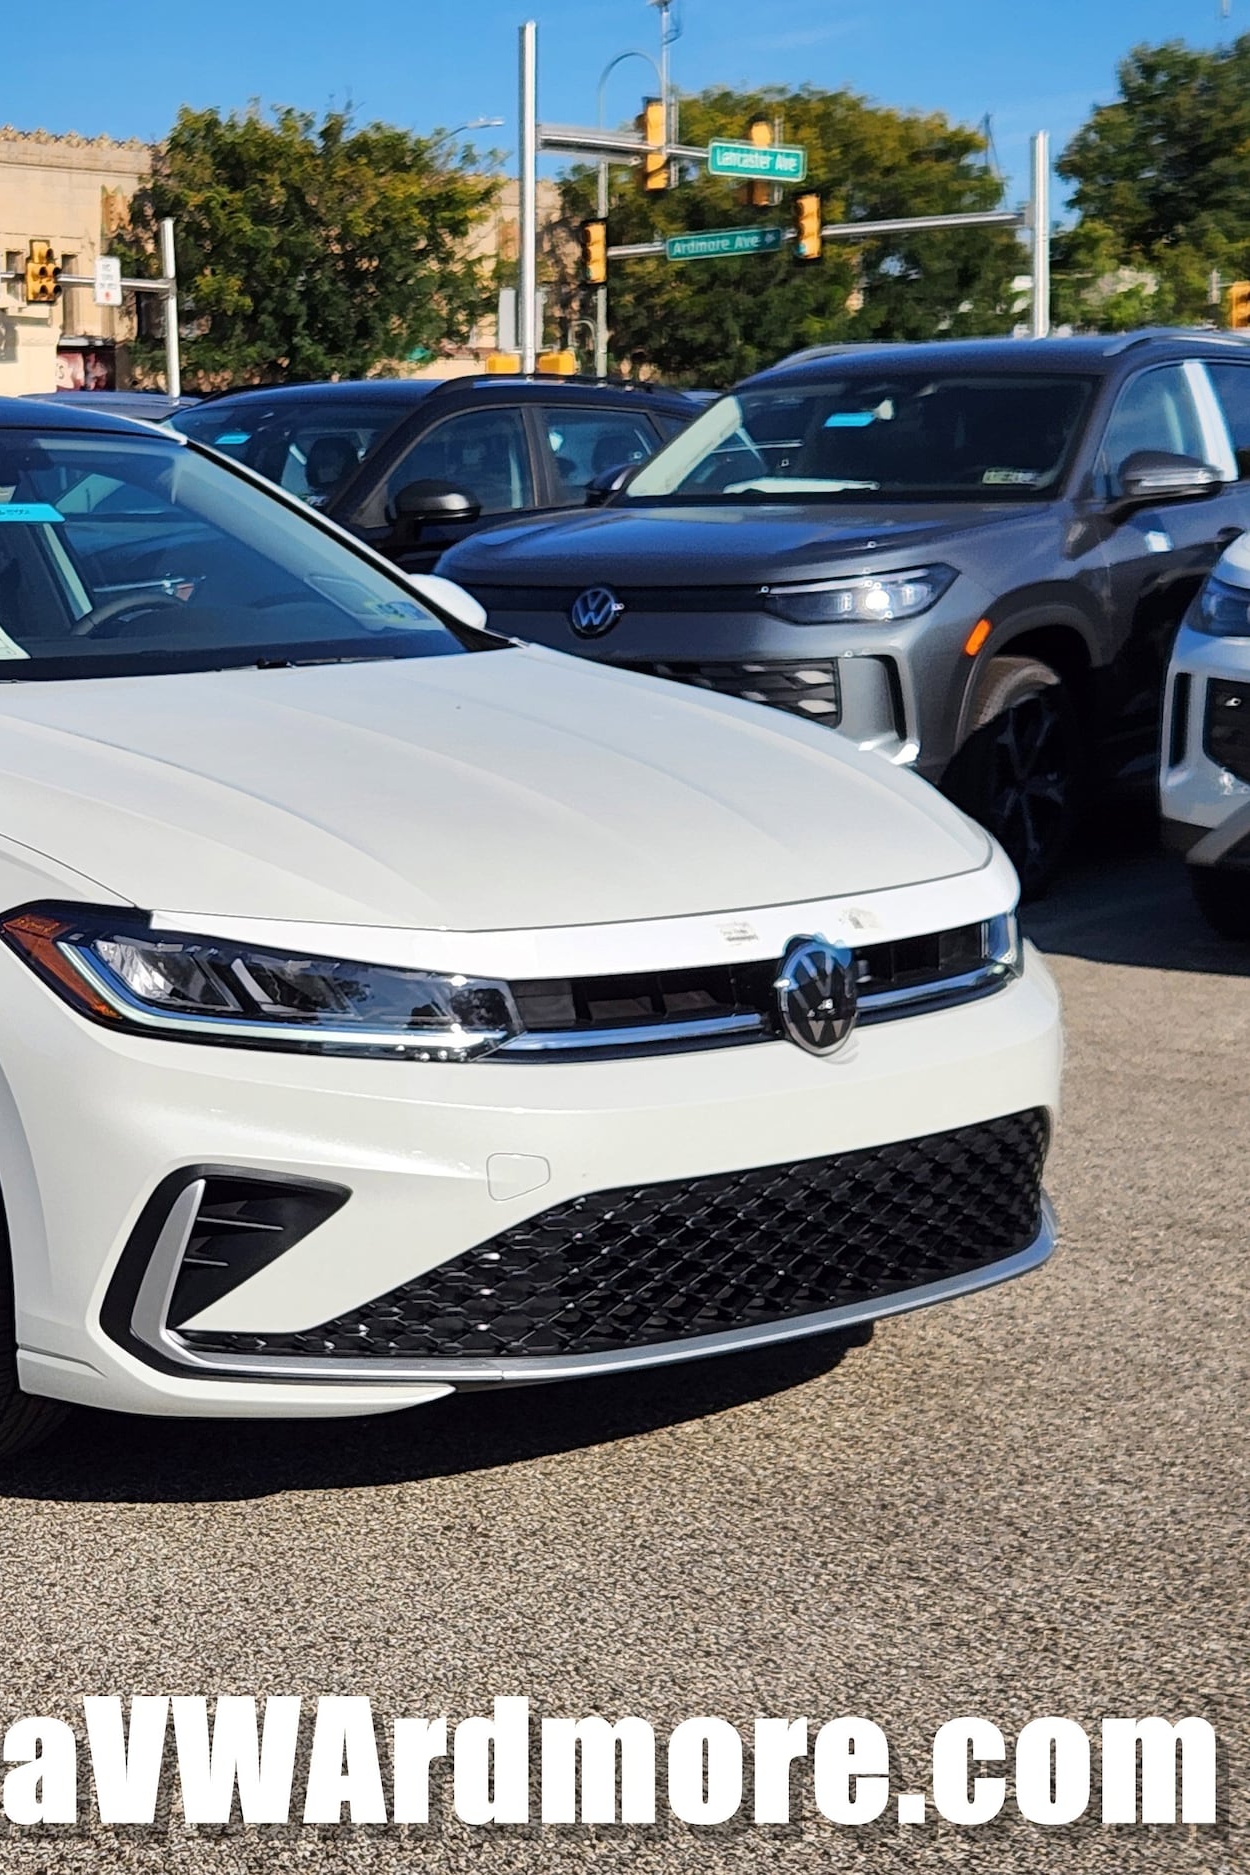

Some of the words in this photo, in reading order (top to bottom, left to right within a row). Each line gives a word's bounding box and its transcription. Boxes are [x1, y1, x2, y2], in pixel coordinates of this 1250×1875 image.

[716, 147, 771, 169] Lancaster
[774, 154, 798, 172] Ave
[672, 237, 730, 255] Ardmore
[734, 234, 760, 249] Ave
